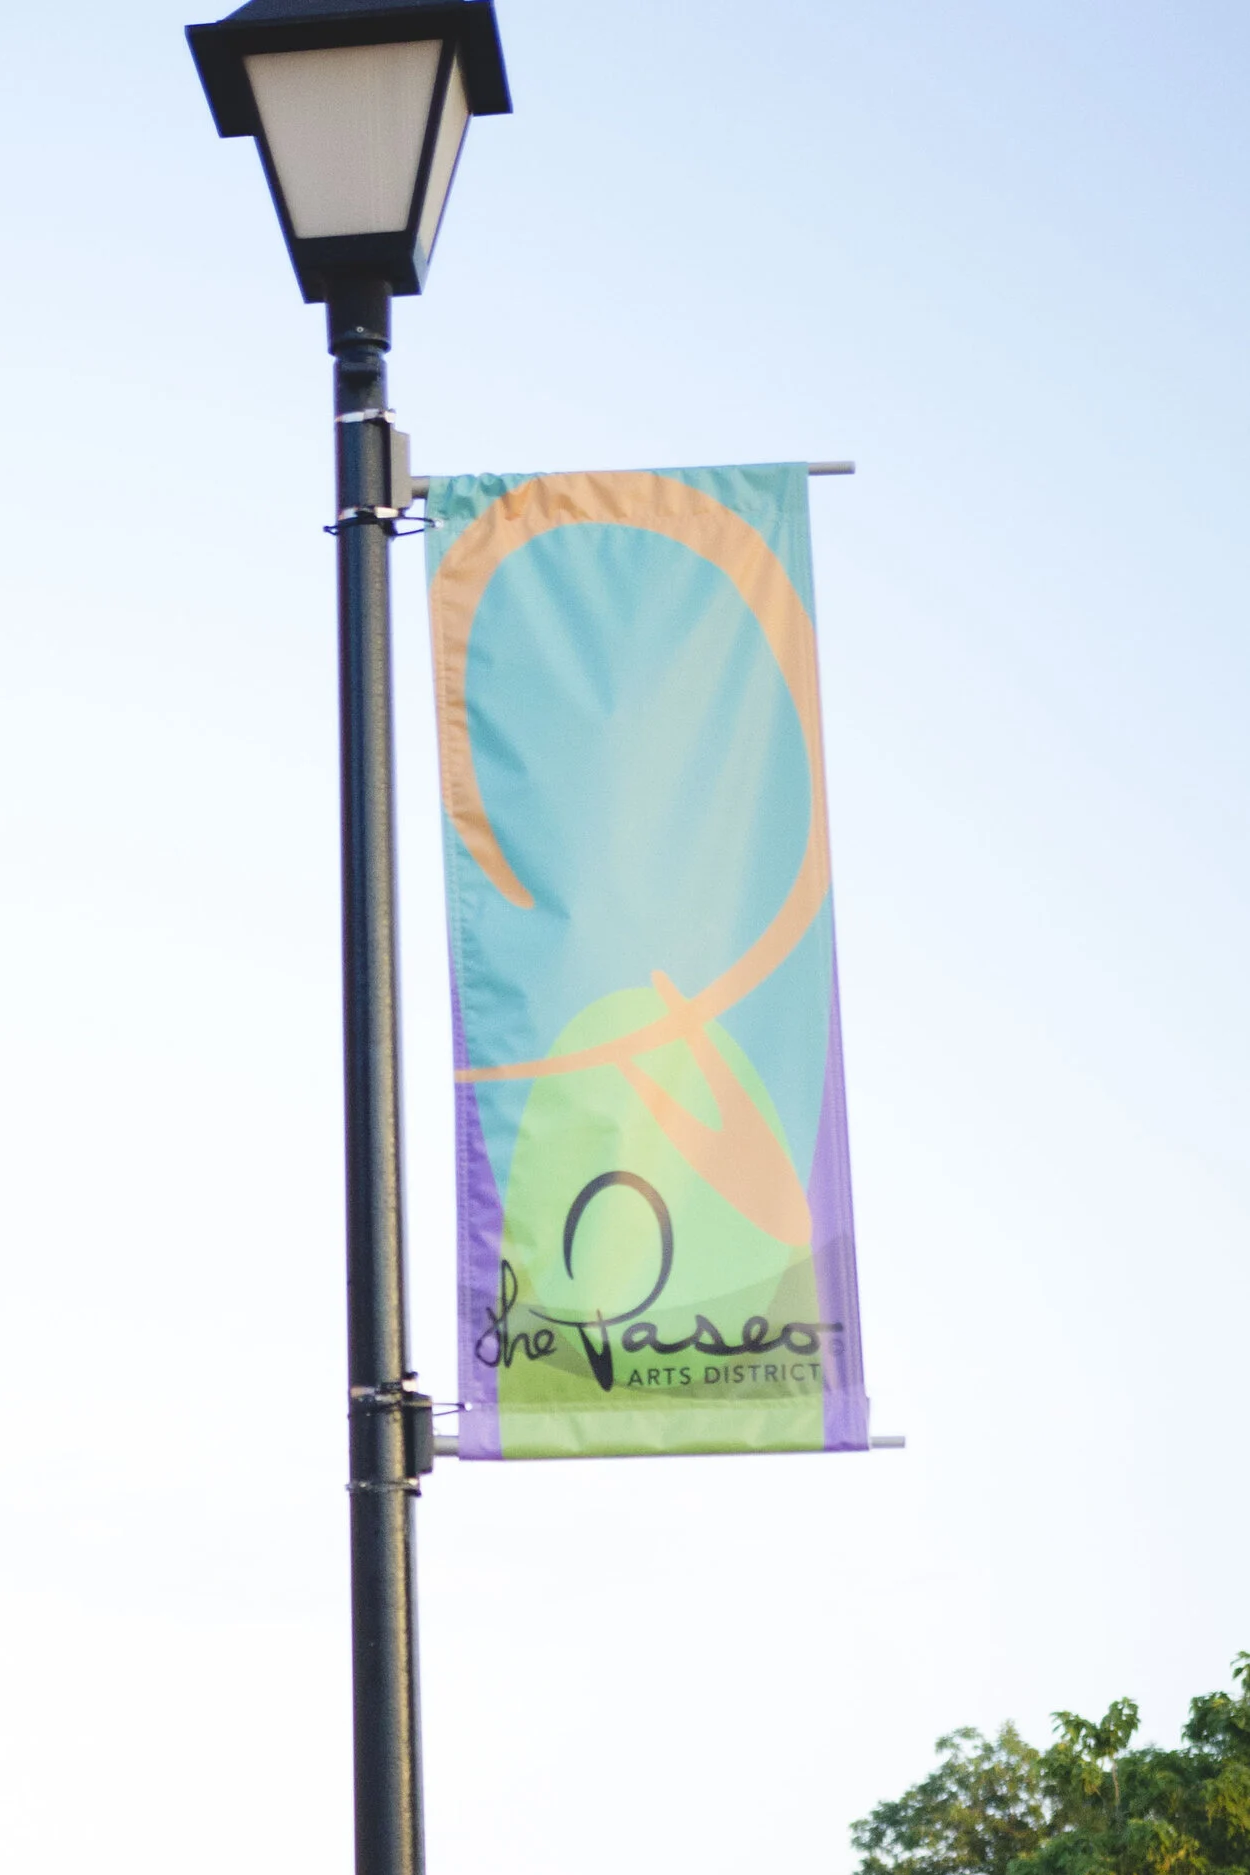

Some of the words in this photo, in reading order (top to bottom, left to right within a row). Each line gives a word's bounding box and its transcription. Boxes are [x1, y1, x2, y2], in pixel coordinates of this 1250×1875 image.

[529, 1170, 844, 1393] Paseo
[627, 1367, 691, 1386] ARTS
[704, 1363, 821, 1385] DISTRICT
